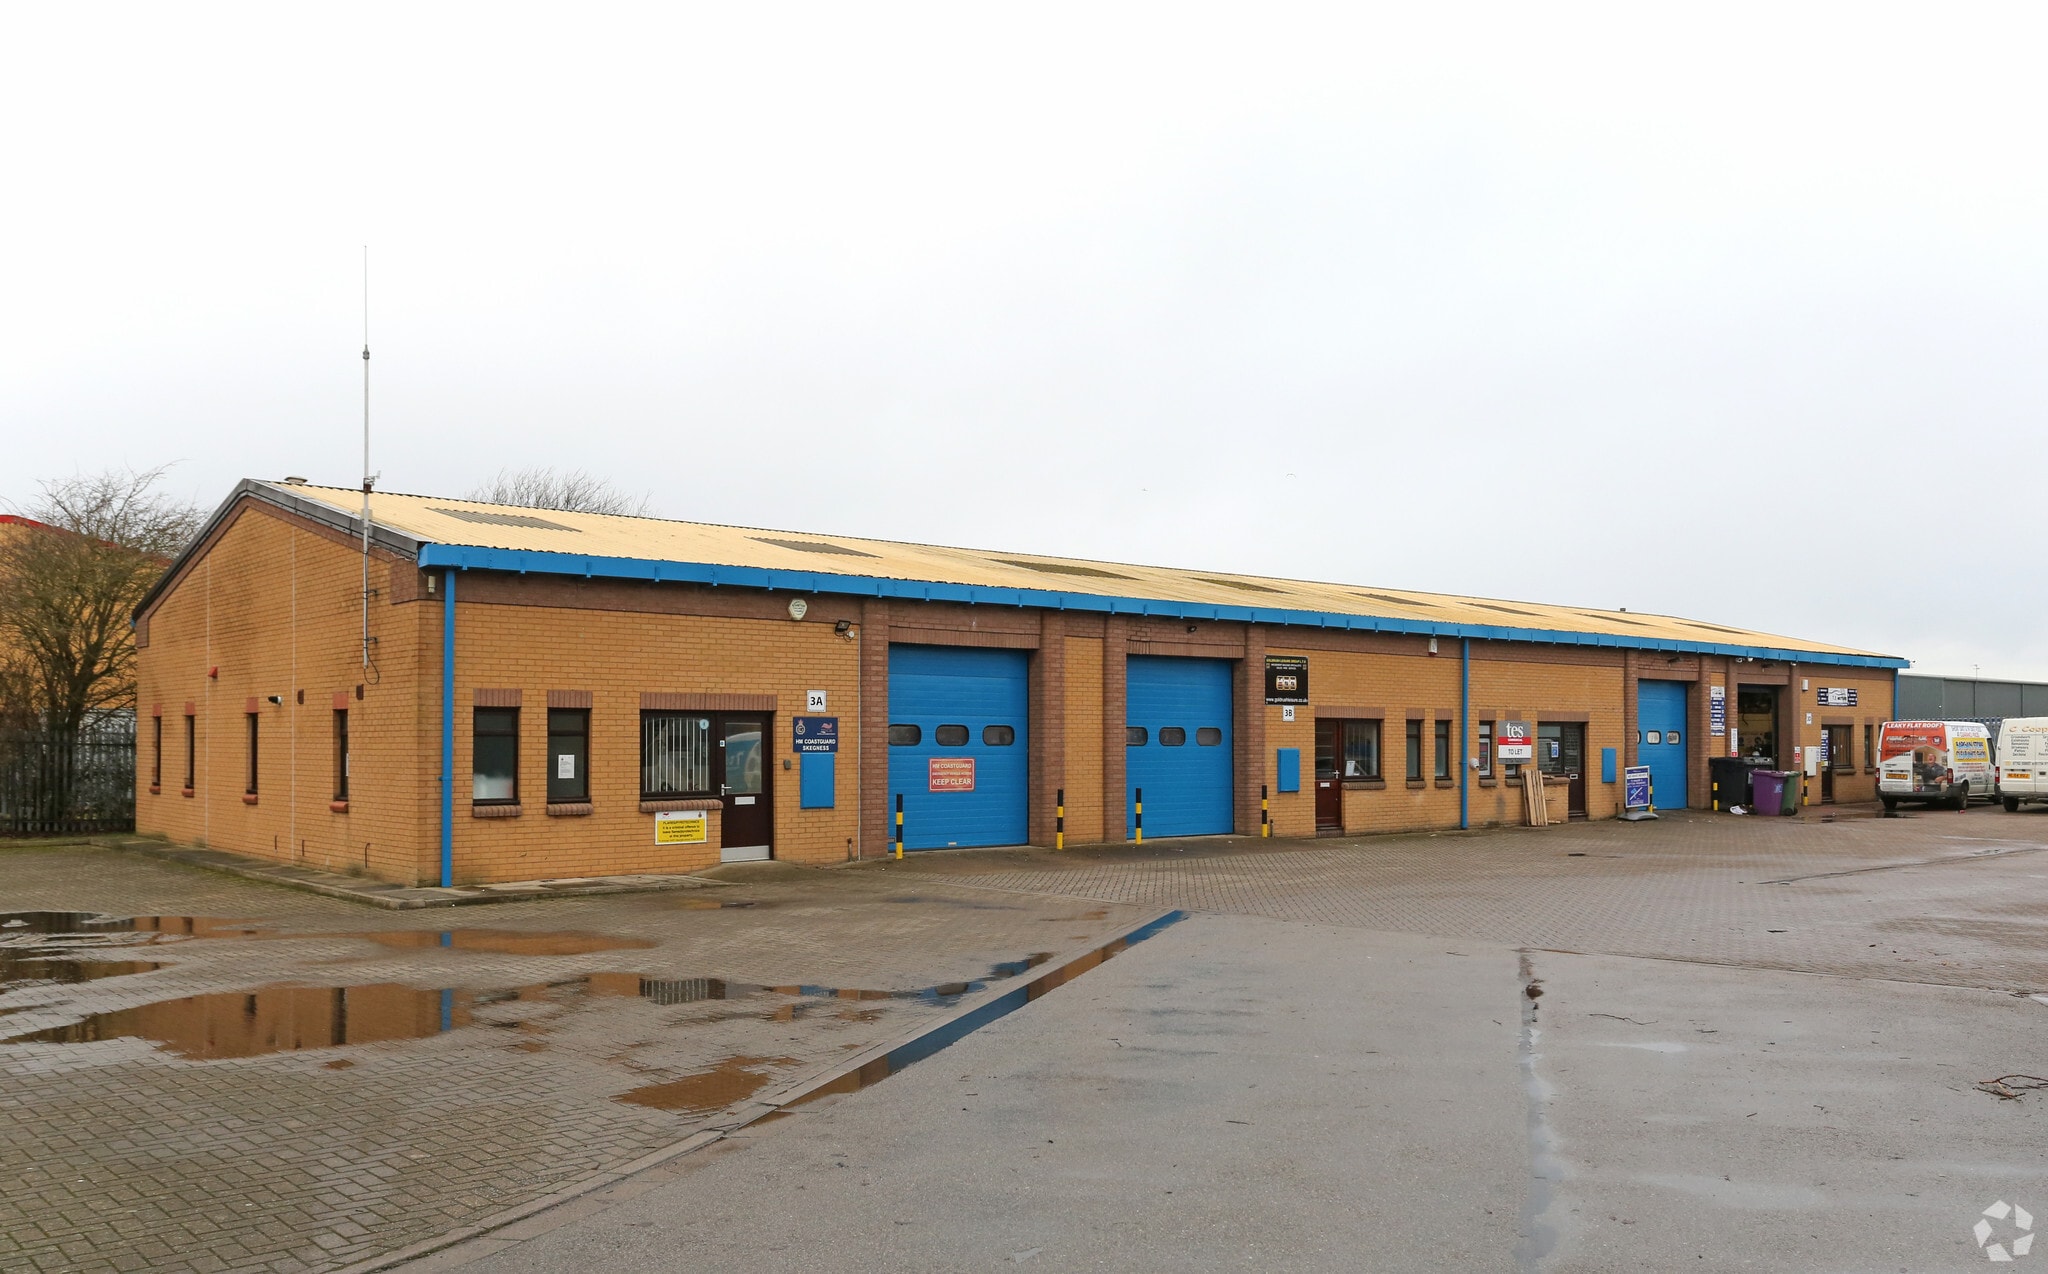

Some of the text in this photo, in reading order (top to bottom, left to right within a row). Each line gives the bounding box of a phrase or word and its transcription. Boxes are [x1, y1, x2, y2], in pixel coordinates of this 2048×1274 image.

[810, 696, 823, 706] 3A
[1284, 709, 1293, 717] 3B
[1506, 722, 1524, 738] tes
[932, 778, 950, 786] KEEP
